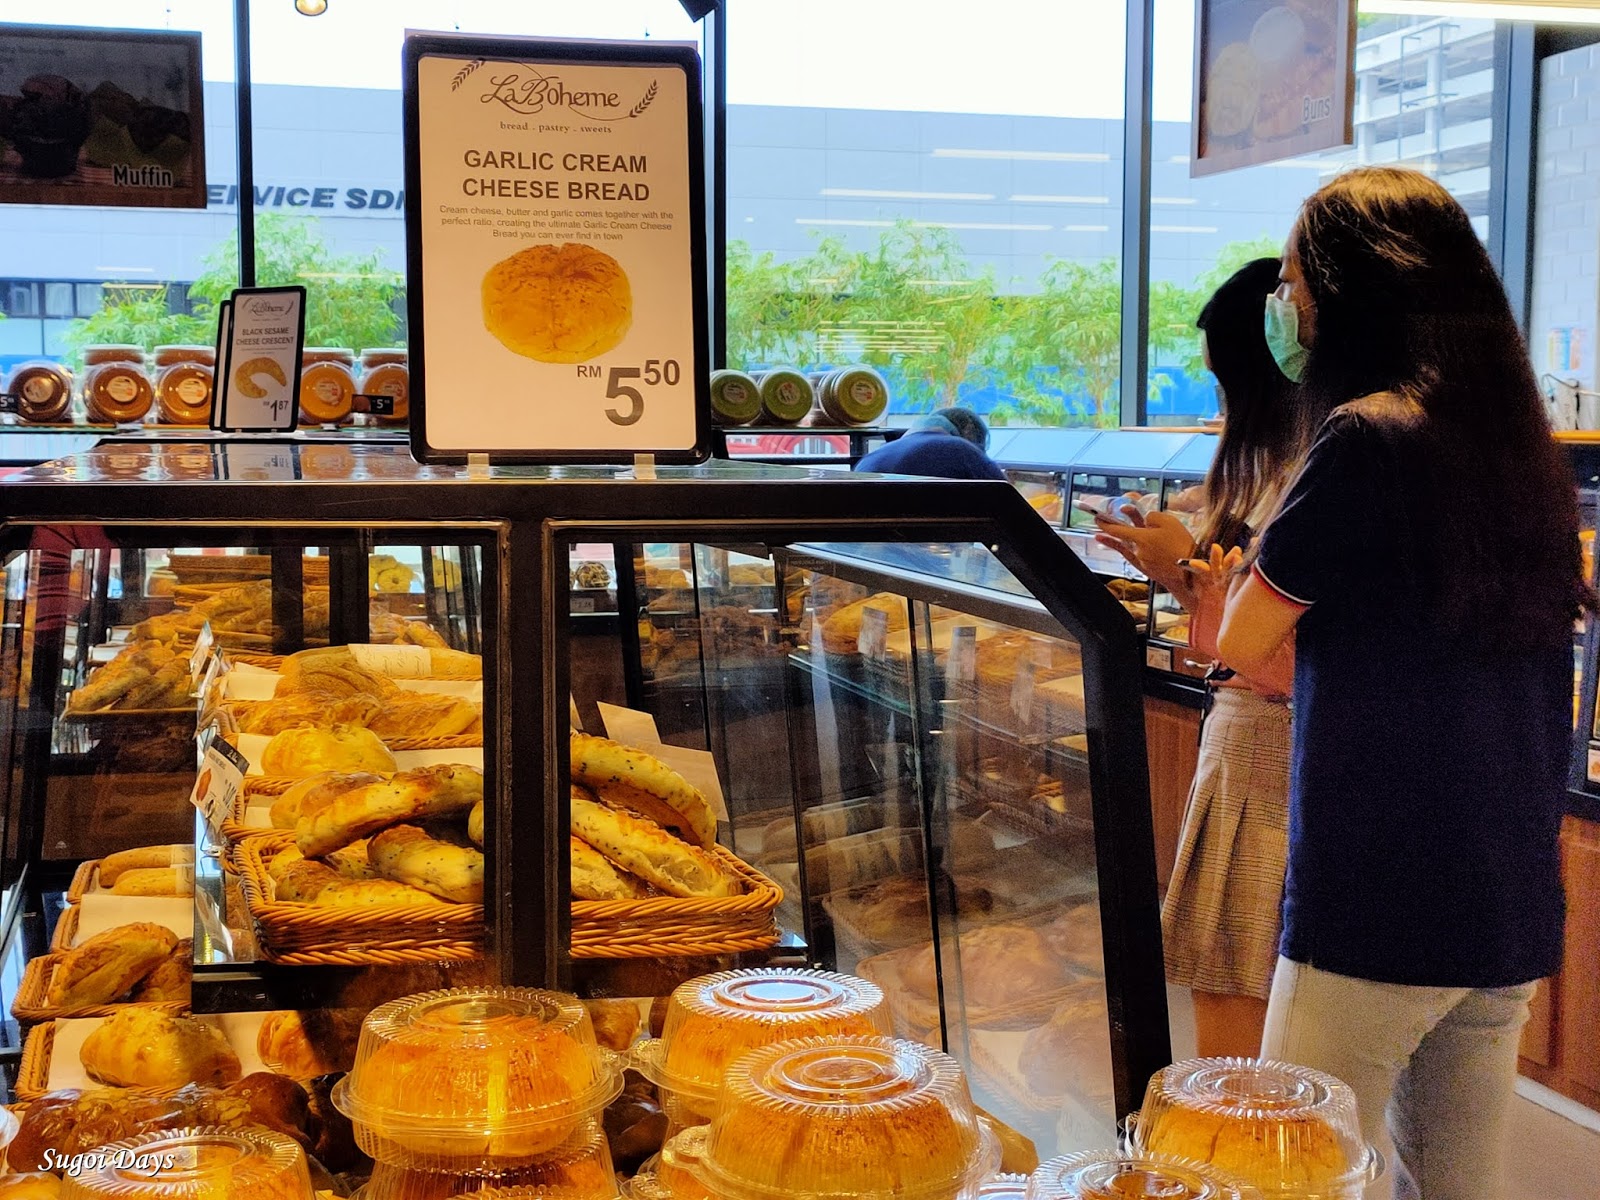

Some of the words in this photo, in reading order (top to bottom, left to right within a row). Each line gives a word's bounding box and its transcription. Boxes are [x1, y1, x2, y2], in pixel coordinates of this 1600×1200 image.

[1302, 97, 1331, 122] Buns
[499, 121, 529, 131] bread
[538, 124, 571, 134] pastry
[580, 126, 612, 134] sweets
[464, 150, 553, 170] GARLIC
[563, 154, 646, 173] CREAM
[112, 164, 173, 188] Muffin
[463, 178, 559, 199] CHEESE
[568, 182, 649, 201] BREAD
[440, 205, 468, 214] Cream
[506, 208, 531, 216] butter
[533, 209, 549, 217] and
[550, 209, 573, 219] garlic
[605, 210, 640, 220] together
[641, 211, 658, 219] with
[441, 217, 472, 226] perfect
[497, 219, 530, 229] creating
[548, 220, 581, 228] ultimate
[583, 220, 608, 229] Garlic
[610, 221, 638, 229] Cream
[640, 222, 672, 230] Cheese
[493, 229, 518, 238] Bread
[520, 232, 537, 240] you
[242, 328, 263, 336] BLACK
[264, 327, 289, 335] SESAME
[236, 338, 260, 346] CHEESE
[261, 336, 294, 345] CRESCENT
[577, 365, 601, 378] RM
[643, 359, 680, 385] 50
